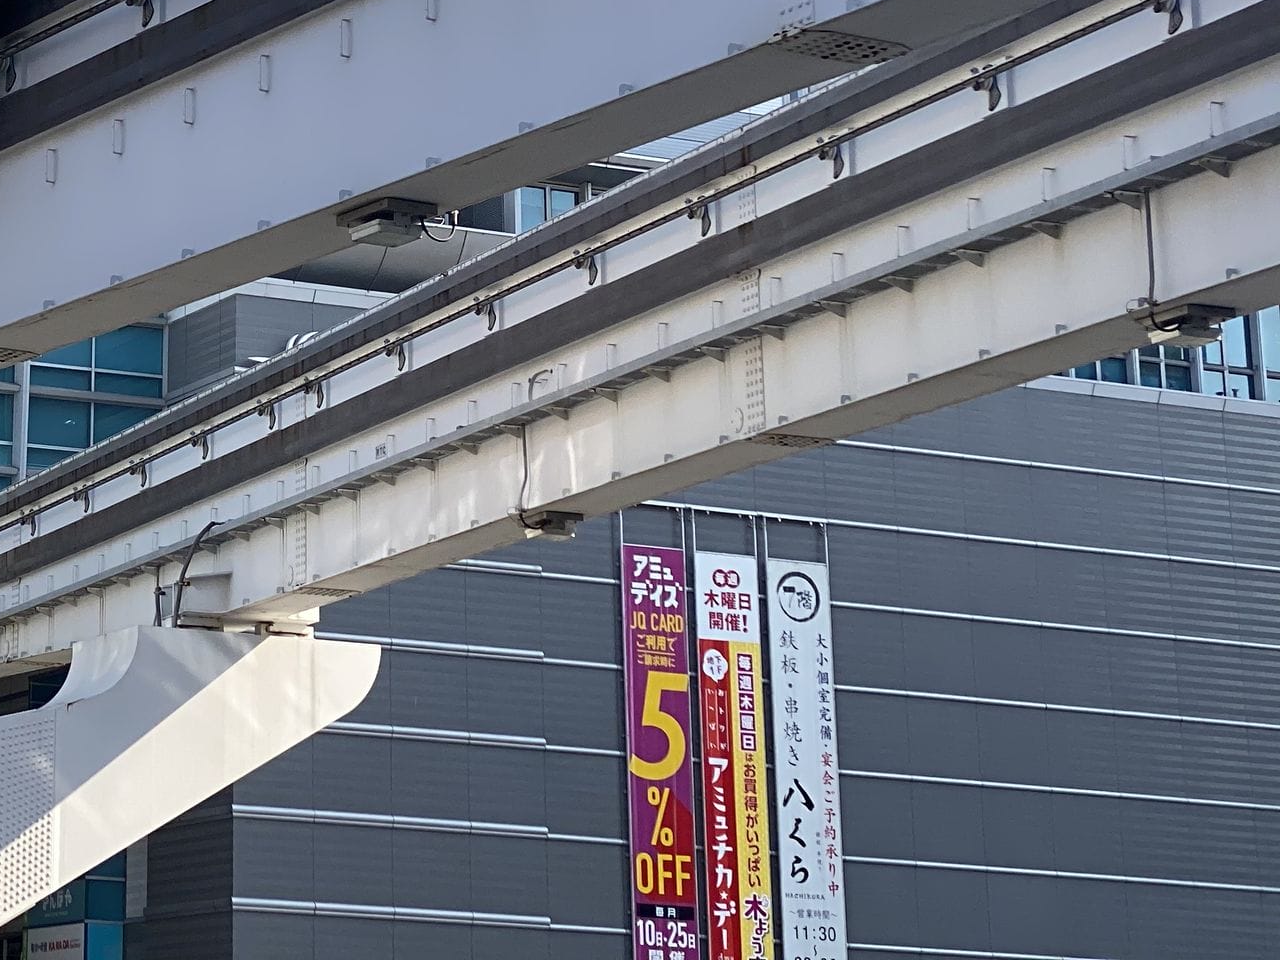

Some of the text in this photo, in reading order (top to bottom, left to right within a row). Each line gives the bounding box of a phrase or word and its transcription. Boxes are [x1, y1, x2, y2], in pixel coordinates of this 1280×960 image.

[633, 554, 673, 580] アミュ
[713, 569, 740, 588] 毎週
[631, 579, 683, 608] デイズ
[704, 589, 751, 611] 木曜日
[782, 586, 812, 610] 7階
[630, 611, 684, 633] JQ CARD
[636, 634, 677, 651] ご利用で
[637, 654, 676, 667] ご請求時に
[782, 778, 815, 884] 八くら
[636, 852, 691, 896] OFF
[745, 894, 769, 960] 木よう
[793, 925, 836, 941] 11:30
